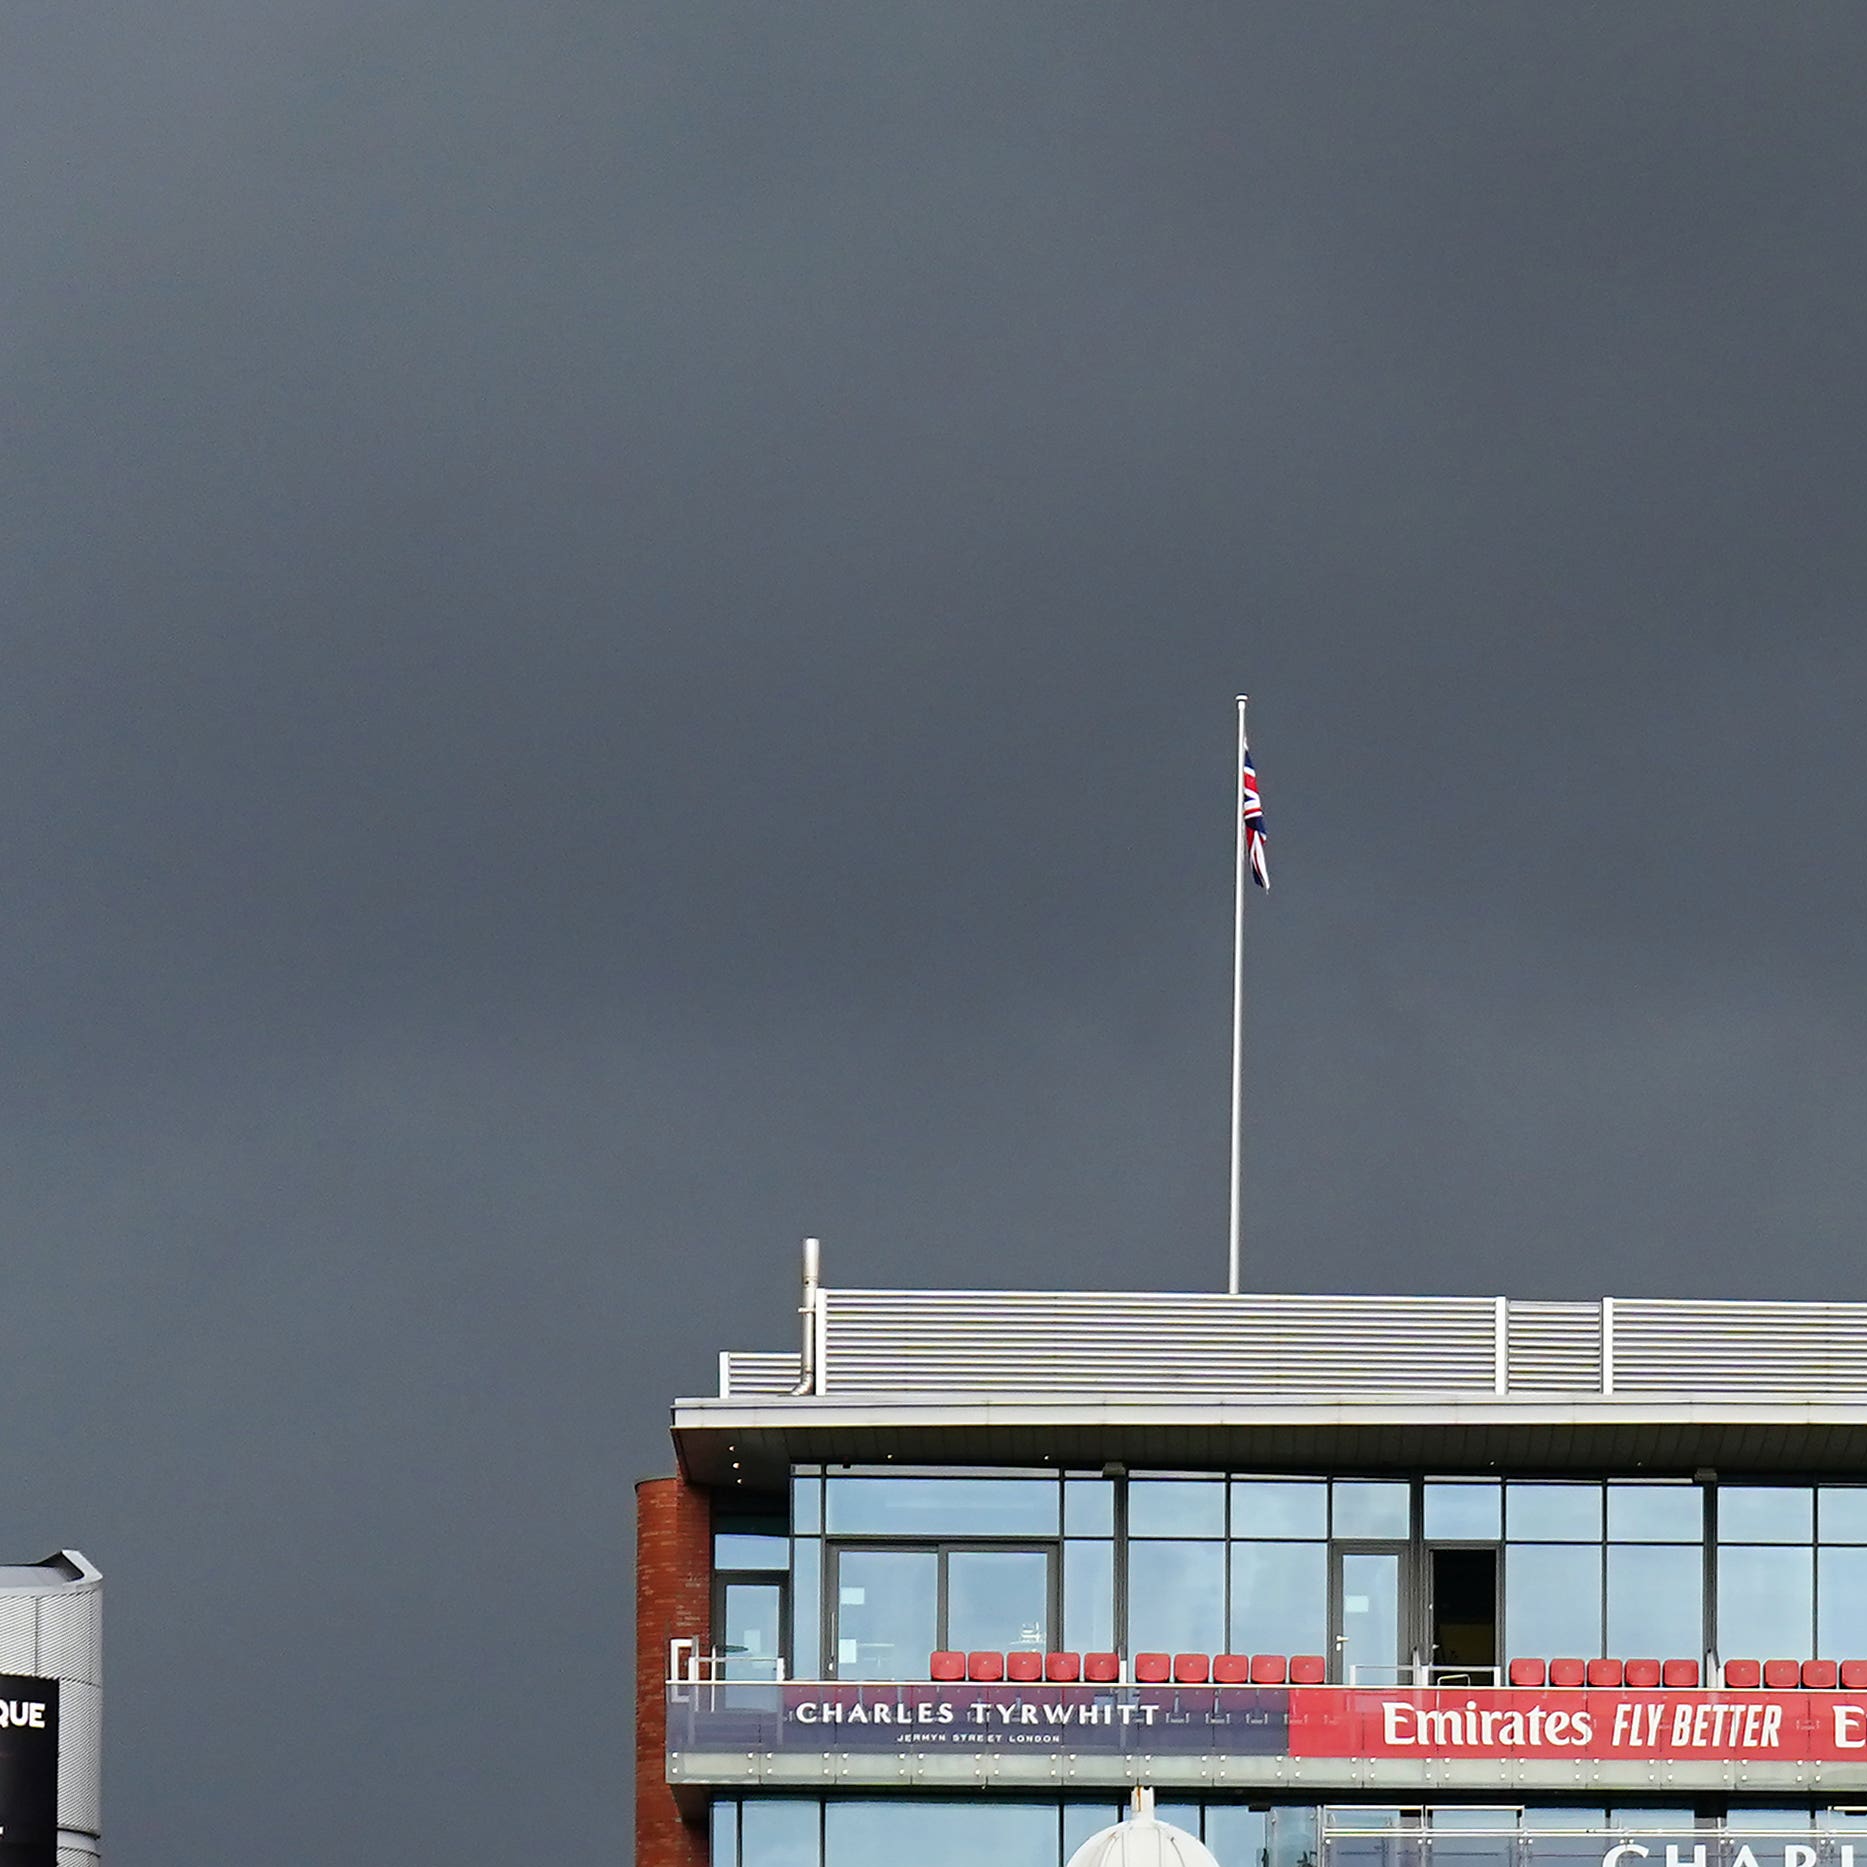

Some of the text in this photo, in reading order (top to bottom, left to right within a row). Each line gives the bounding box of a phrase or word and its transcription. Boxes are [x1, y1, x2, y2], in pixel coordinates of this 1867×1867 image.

[796, 1702, 1160, 1725] CHARLES TYRWHITT
[1382, 1701, 1783, 1748] Emirates FLY BETTER
[897, 1733, 1060, 1743] JERMYN STREET LONDON
